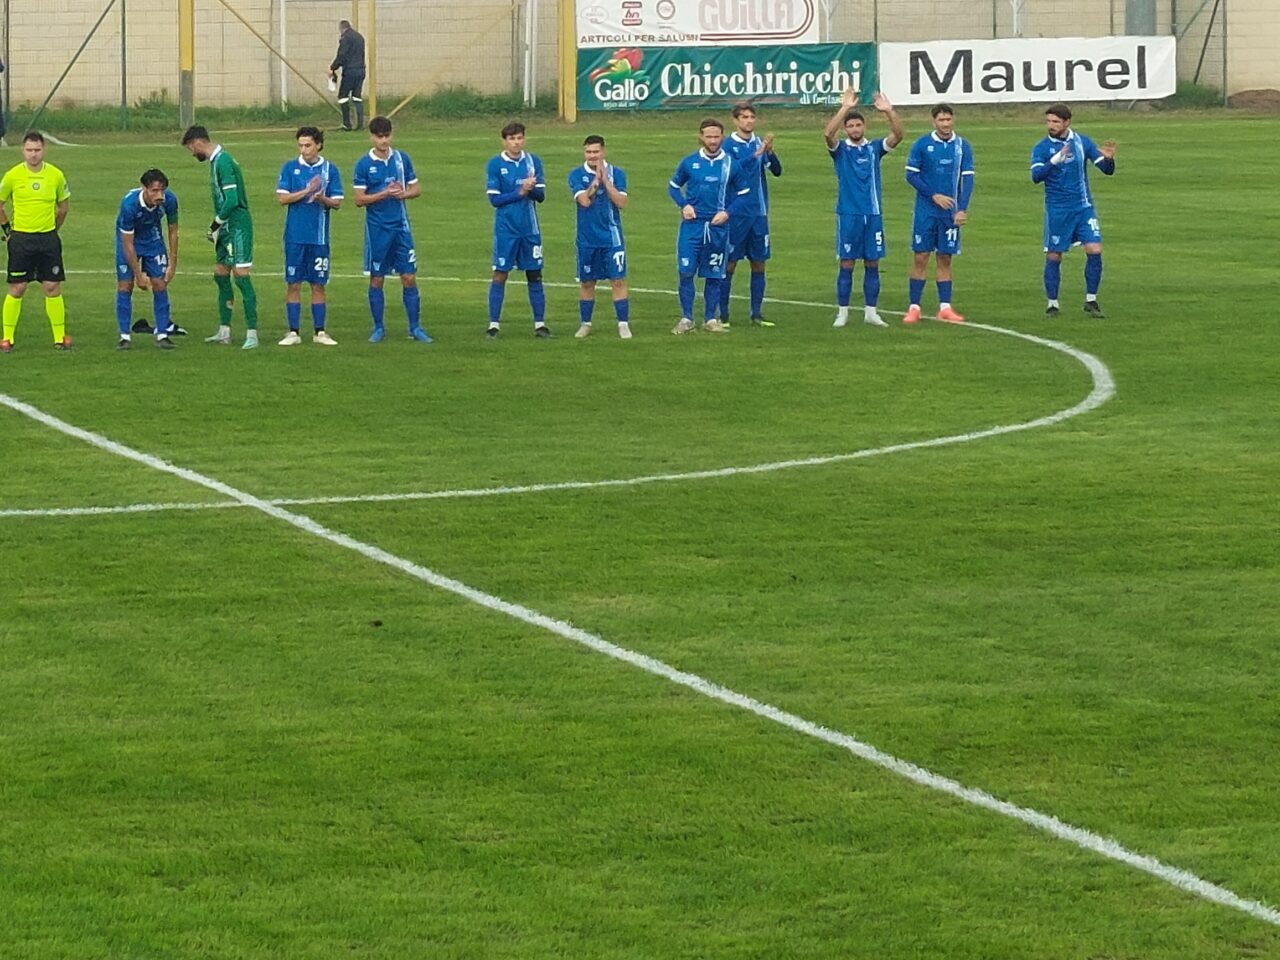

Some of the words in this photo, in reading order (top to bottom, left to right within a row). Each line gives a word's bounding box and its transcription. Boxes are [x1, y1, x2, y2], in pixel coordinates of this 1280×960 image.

[580, 34, 631, 44] ARTICOLI
[634, 34, 655, 43] PER
[910, 46, 1147, 95] Maurel
[661, 61, 861, 97] Chicchiricchi
[595, 79, 649, 101] Gallo
[875, 231, 883, 245] 5
[946, 228, 958, 242] 11
[155, 254, 168, 266] 14
[314, 258, 329, 271] 29
[709, 253, 724, 266] 21
